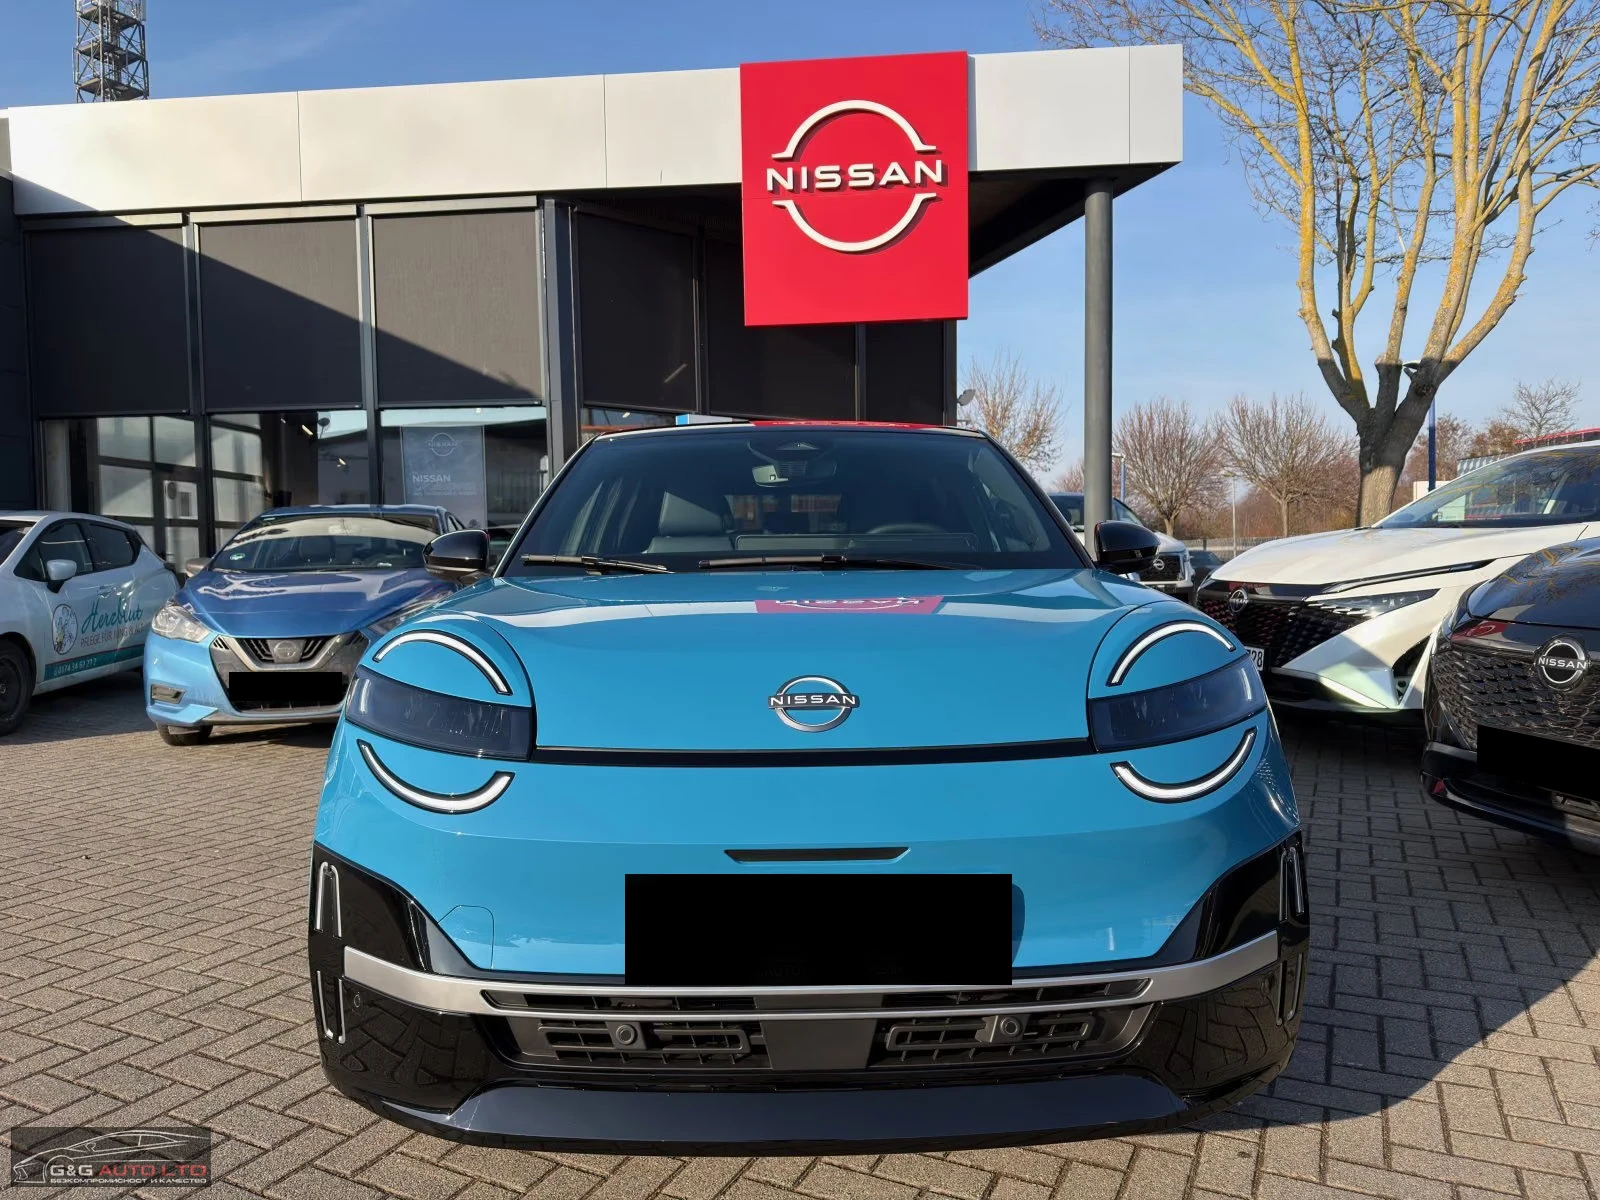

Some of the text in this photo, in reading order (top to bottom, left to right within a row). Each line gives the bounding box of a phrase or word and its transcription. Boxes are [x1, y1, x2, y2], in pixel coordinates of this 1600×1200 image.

[766, 159, 943, 192] NISSAN
[412, 474, 451, 482] NISSAN
[1538, 657, 1587, 669] NISSAN
[770, 694, 856, 706] NISSAN
